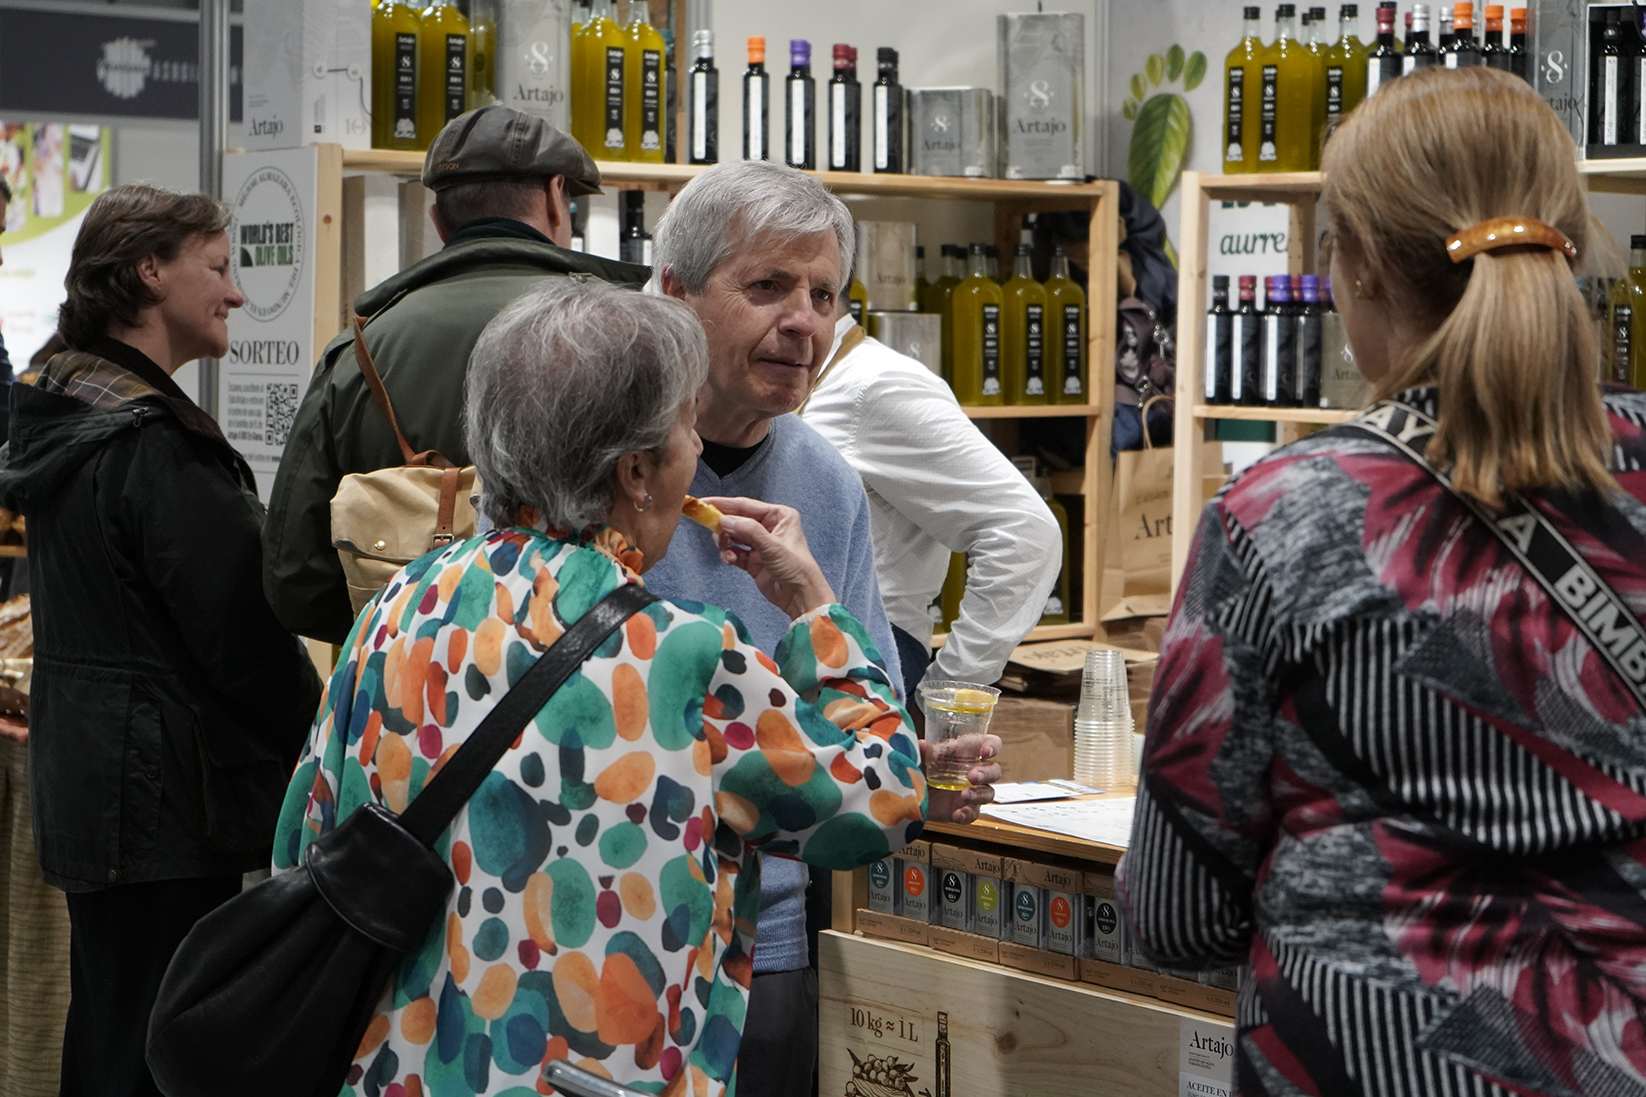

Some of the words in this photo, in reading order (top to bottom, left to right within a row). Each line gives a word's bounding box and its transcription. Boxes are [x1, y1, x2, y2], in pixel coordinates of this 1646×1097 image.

[513, 84, 565, 106] Artajo
[249, 114, 283, 139] Artajo
[1012, 118, 1067, 136] Artajo
[921, 138, 962, 152] Artajo
[240, 222, 273, 245] WORLD'S
[276, 222, 294, 244] BEST
[1220, 232, 1287, 255] aurre
[256, 246, 275, 266] OLIVE
[277, 244, 294, 266] OILS
[229, 340, 300, 365] SORTEO
[1134, 512, 1172, 540] Art
[899, 845, 925, 859] Artajo
[975, 858, 1000, 875] Artajo
[1044, 870, 1071, 887] Artajo
[869, 891, 890, 903] Artajo
[904, 897, 926, 911] Artajo
[943, 905, 963, 919] Artajo
[976, 913, 998, 927] Artajo
[1014, 921, 1037, 935] Artajo
[1049, 929, 1072, 943] Artajo
[1096, 936, 1119, 951] Artajo
[850, 1007, 865, 1028] 10
[867, 1011, 883, 1038] kg
[909, 1022, 918, 1042] L
[1189, 1030, 1234, 1060] Artajo
[1187, 1081, 1215, 1096] ACEITE
